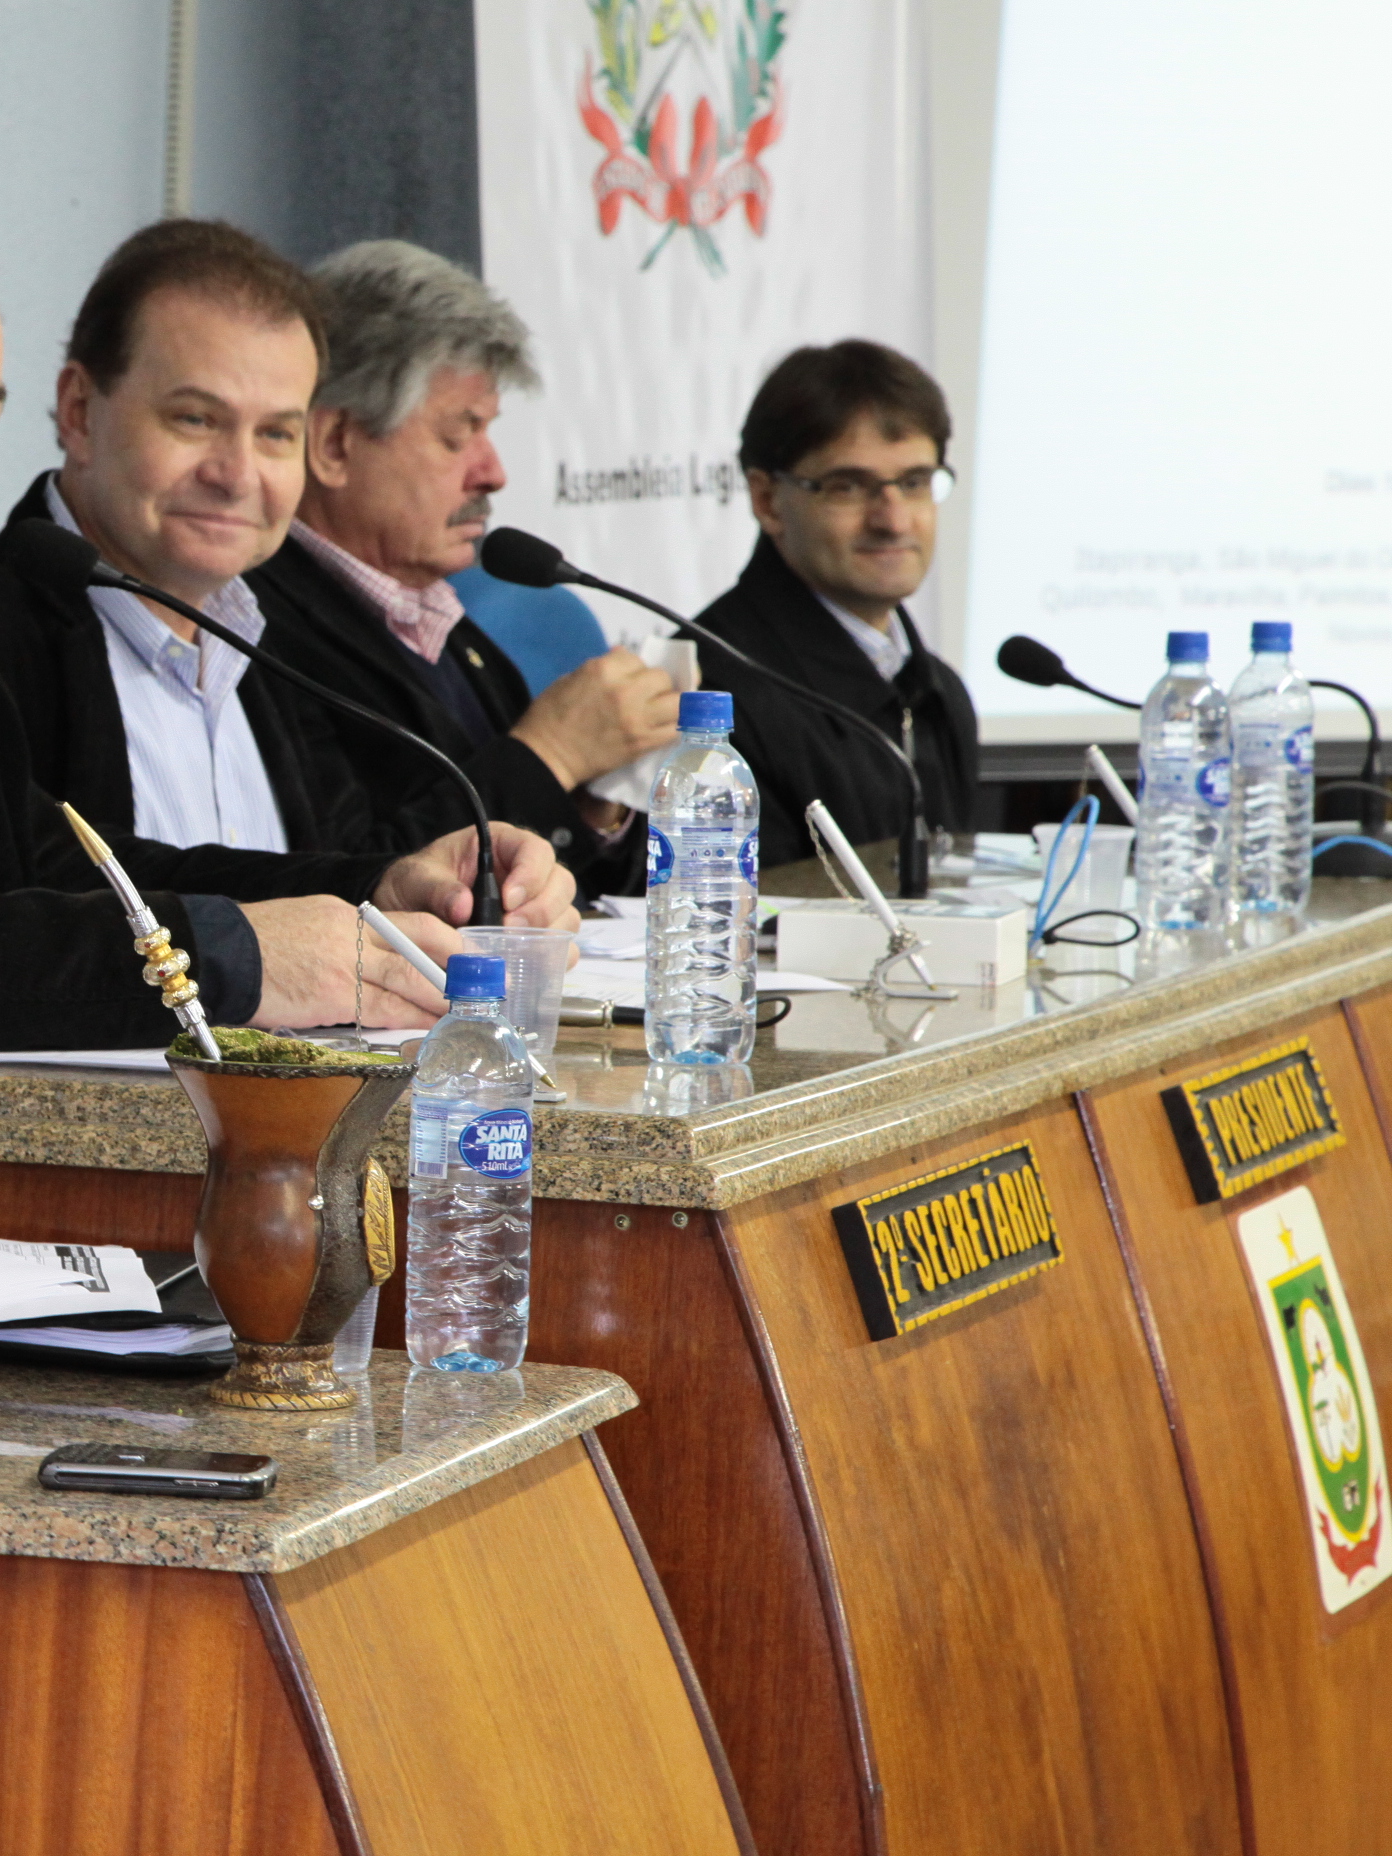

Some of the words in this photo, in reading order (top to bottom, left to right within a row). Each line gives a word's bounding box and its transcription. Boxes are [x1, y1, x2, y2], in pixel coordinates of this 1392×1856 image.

[556, 454, 682, 506] Assembleia
[1209, 1062, 1324, 1166] PRESIDENTE
[475, 1124, 528, 1145] SANTA
[487, 1141, 524, 1161] RITA
